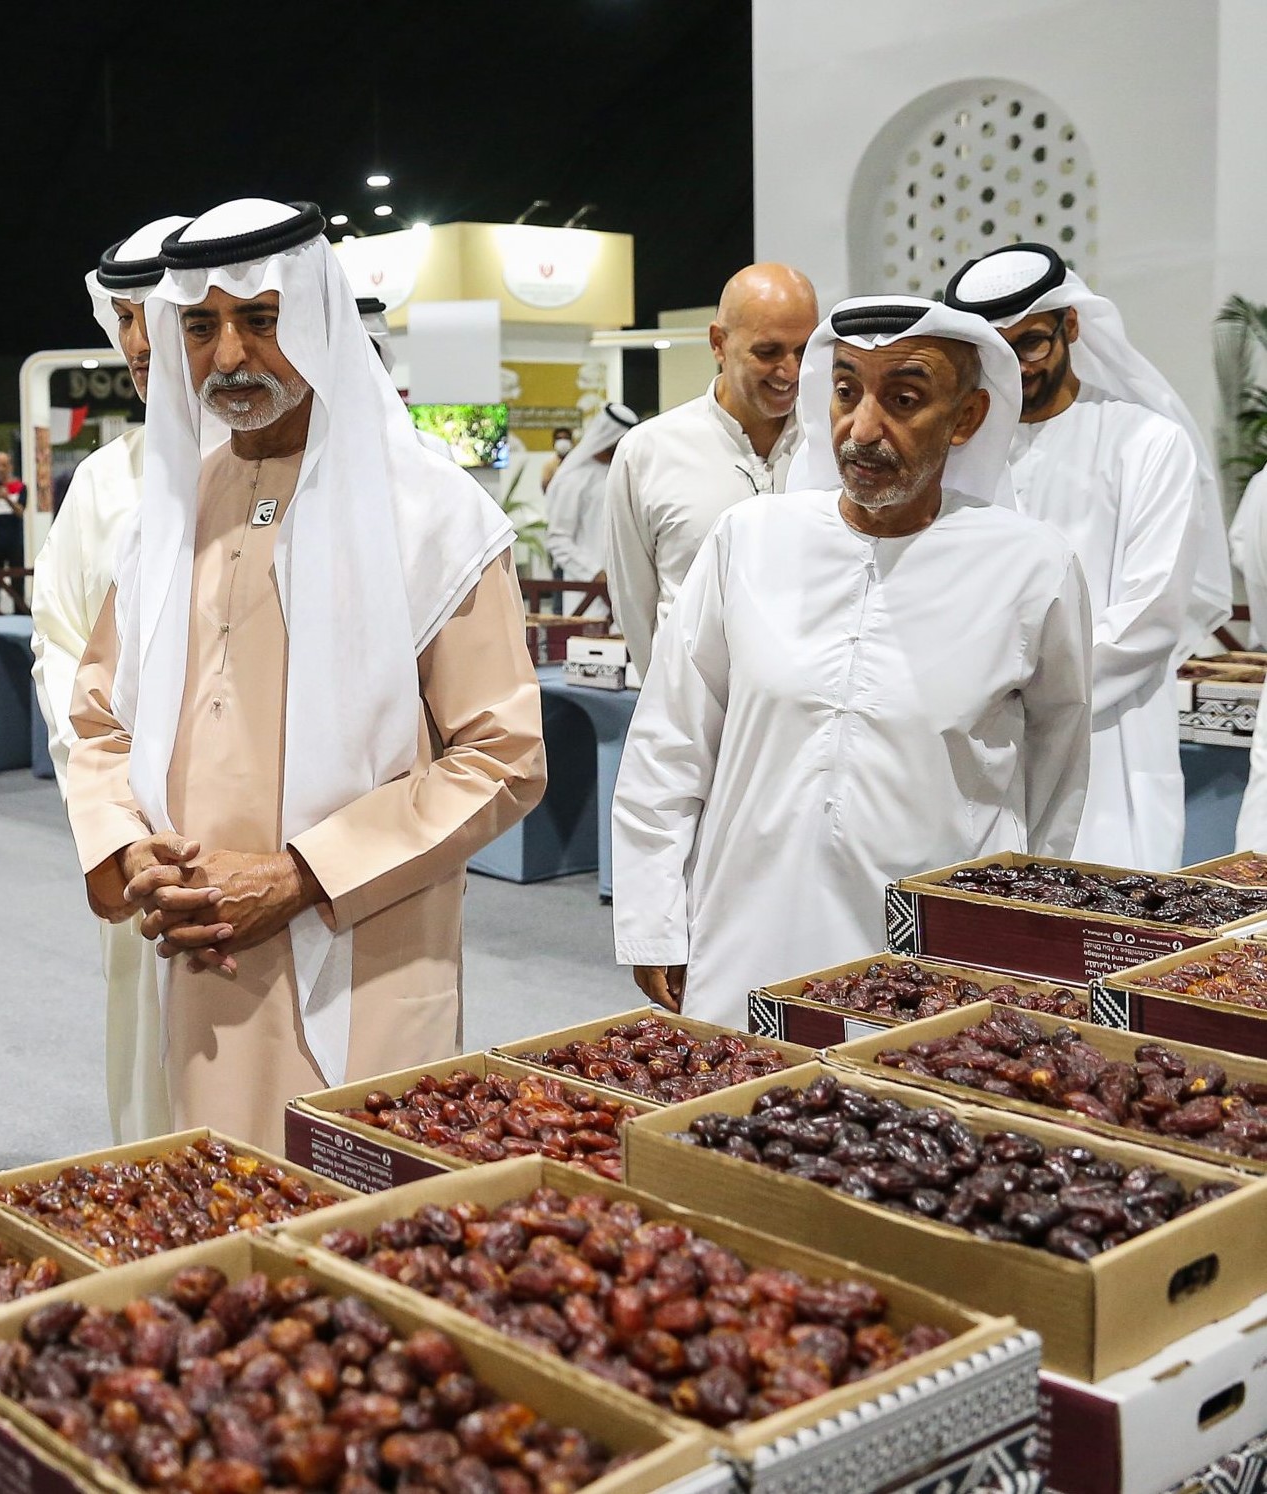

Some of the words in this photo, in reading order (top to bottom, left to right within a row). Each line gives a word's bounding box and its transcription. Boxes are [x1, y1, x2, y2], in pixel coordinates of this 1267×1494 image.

[1083, 941, 1102, 950] Dhabi
[1102, 944, 1115, 953] Abu
[1083, 949, 1110, 960] Heritage
[1120, 947, 1154, 959] Committee
[1111, 954, 1124, 962] and
